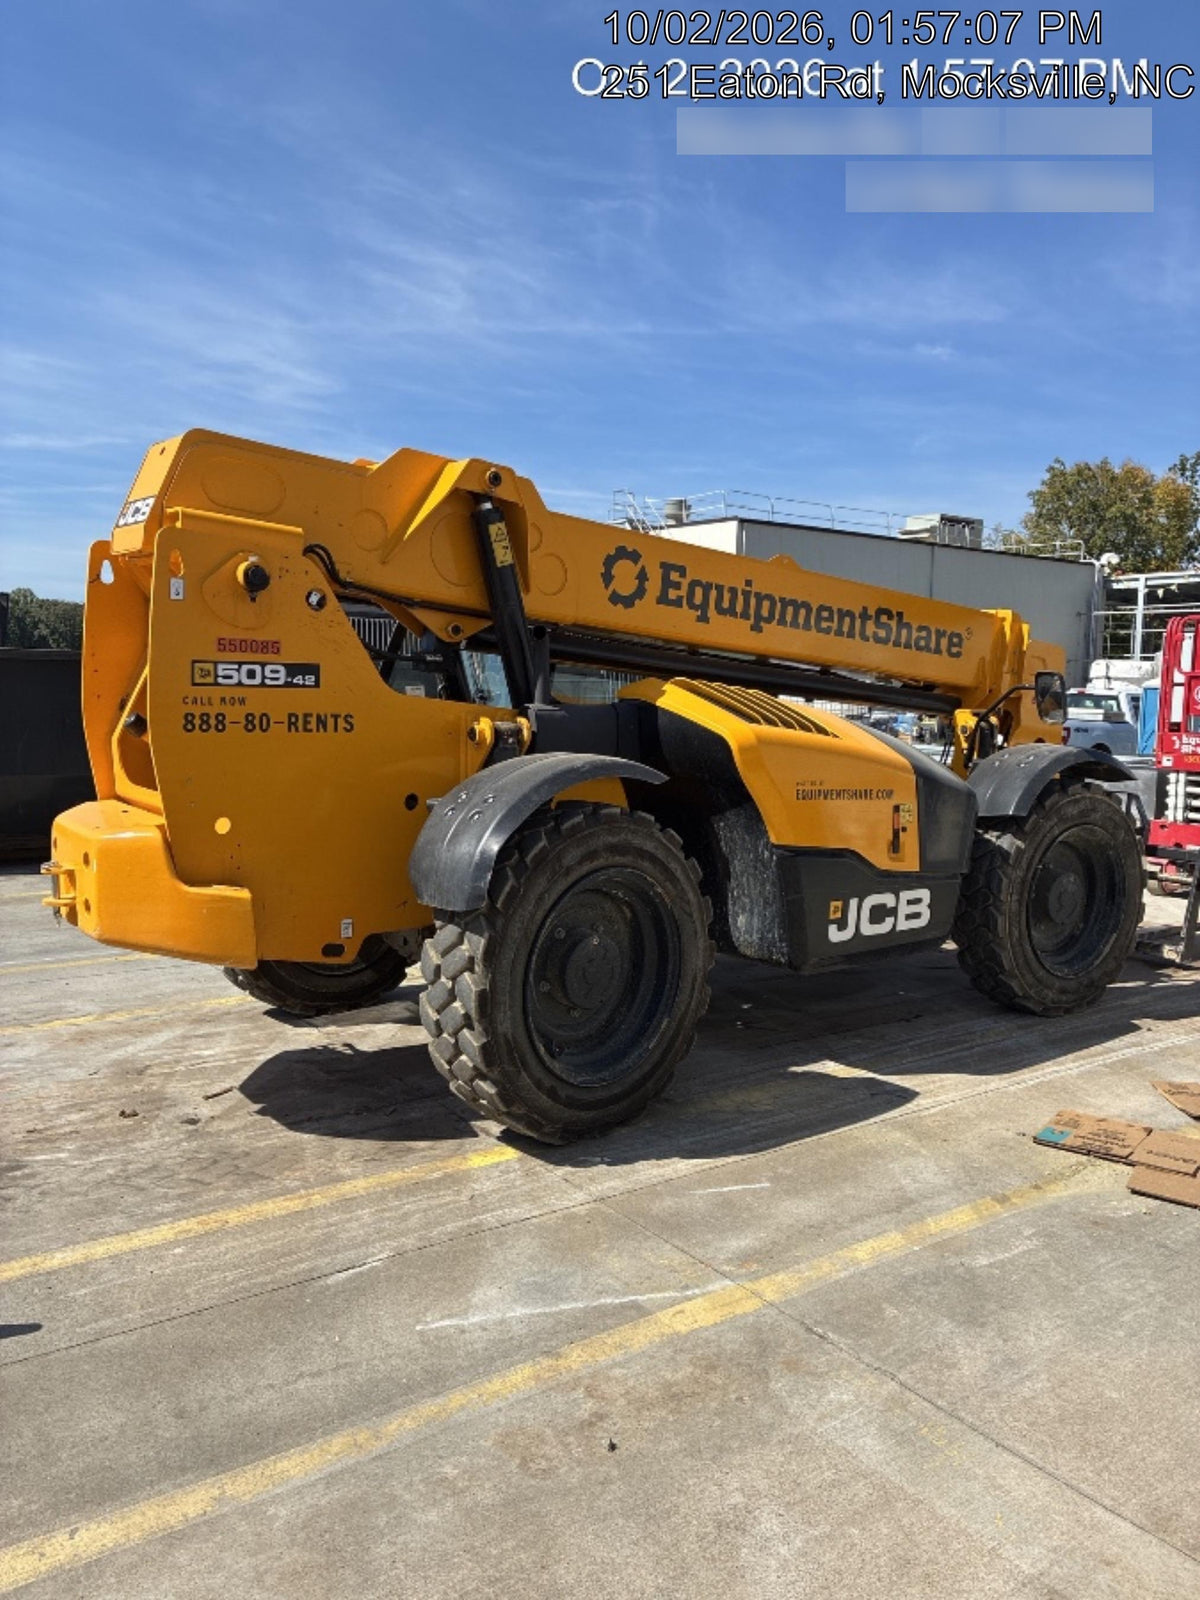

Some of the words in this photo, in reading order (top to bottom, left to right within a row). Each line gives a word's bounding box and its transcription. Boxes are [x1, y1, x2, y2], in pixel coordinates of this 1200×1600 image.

[217, 637, 281, 654] 550085
[216, 663, 316, 686] 509-42
[182, 696, 214, 706] CALL
[220, 697, 247, 706] NOW
[182, 711, 355, 734] 888-80-RENTS
[828, 888, 931, 943] JCB
